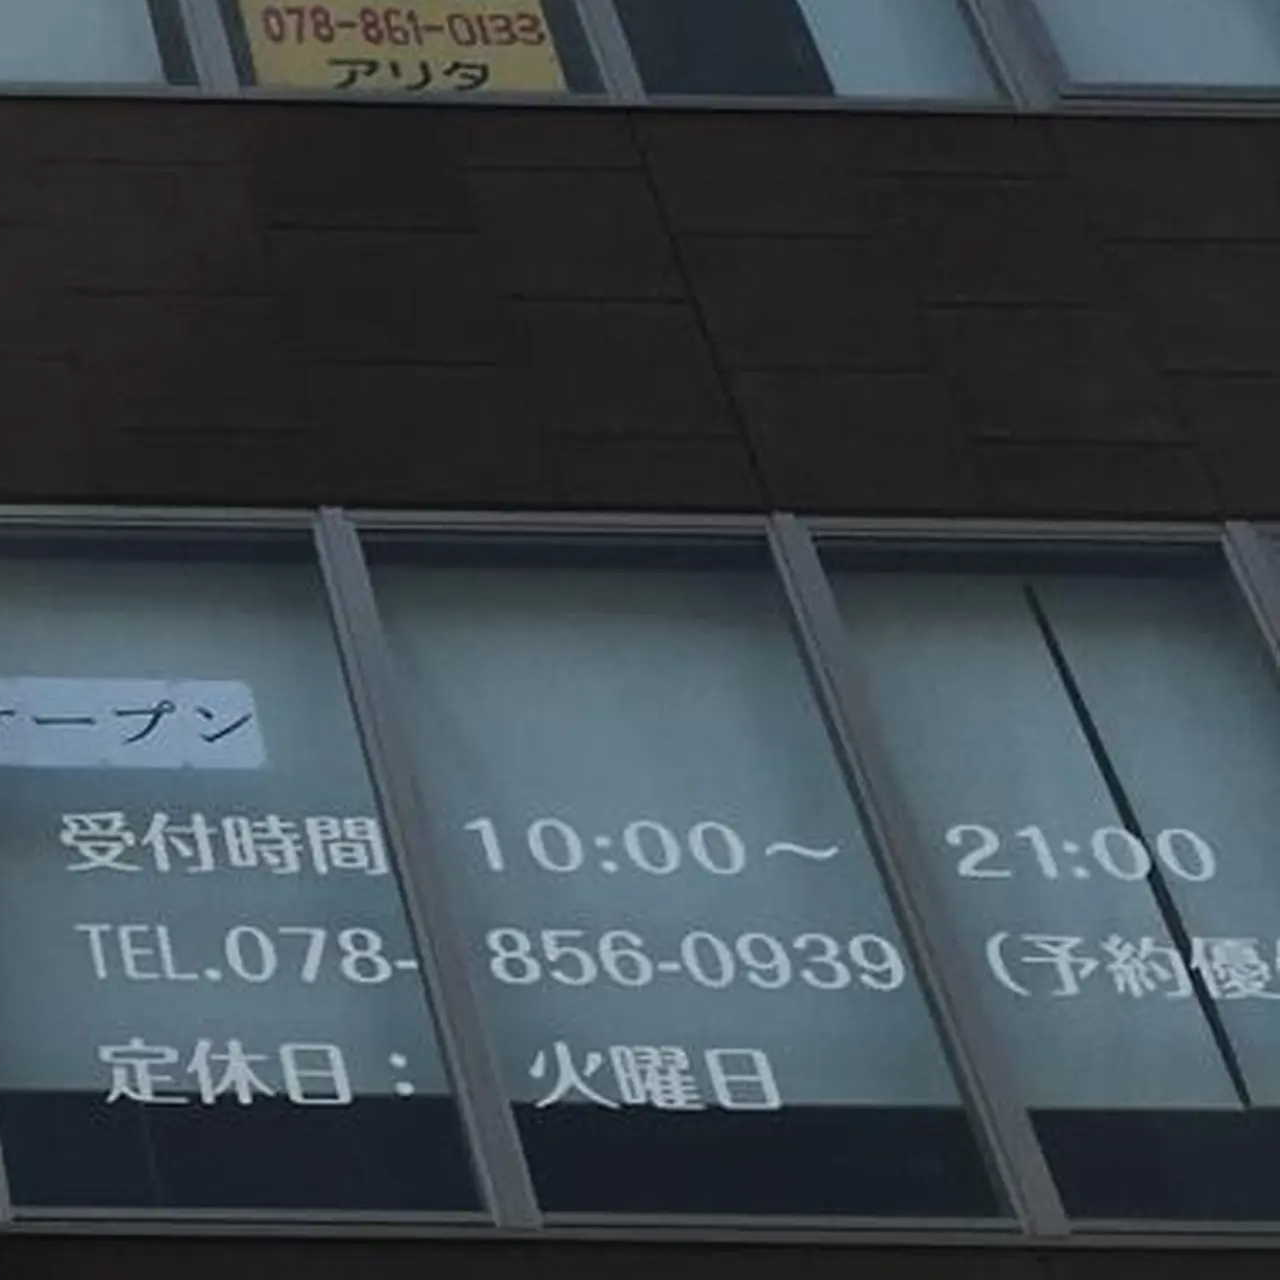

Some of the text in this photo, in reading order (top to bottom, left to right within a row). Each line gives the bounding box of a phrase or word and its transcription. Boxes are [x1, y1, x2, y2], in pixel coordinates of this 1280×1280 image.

[263, 7, 545, 47] 078-861-0133
[328, 58, 490, 91] アリタ
[59, 811, 390, 876] 受付時間
[944, 823, 1218, 882] 21:00
[487, 928, 906, 990] 856-0939
[986, 931, 1280, 1000] (予約優
[528, 1041, 783, 1110] 火曜日
